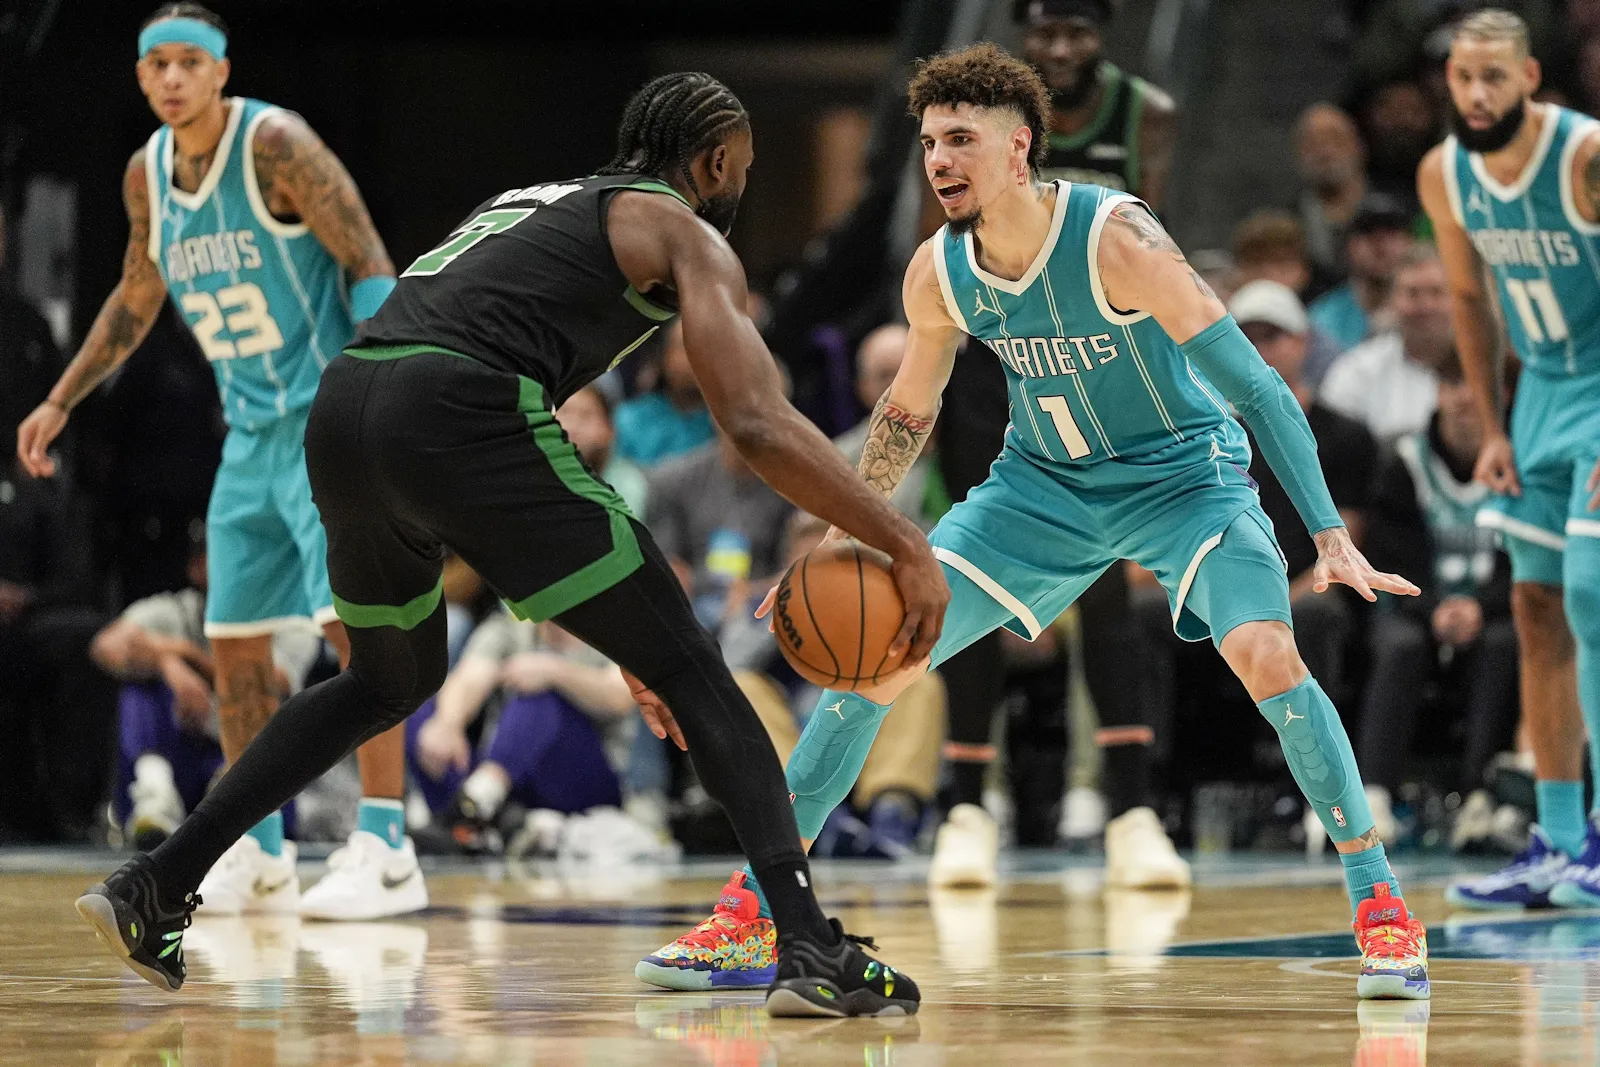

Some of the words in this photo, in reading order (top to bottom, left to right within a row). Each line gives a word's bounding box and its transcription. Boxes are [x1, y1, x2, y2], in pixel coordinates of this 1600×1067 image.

[399, 207, 538, 279] 7
[181, 282, 285, 361] 23
[1505, 278, 1569, 342] 11
[1035, 394, 1093, 462] 1
